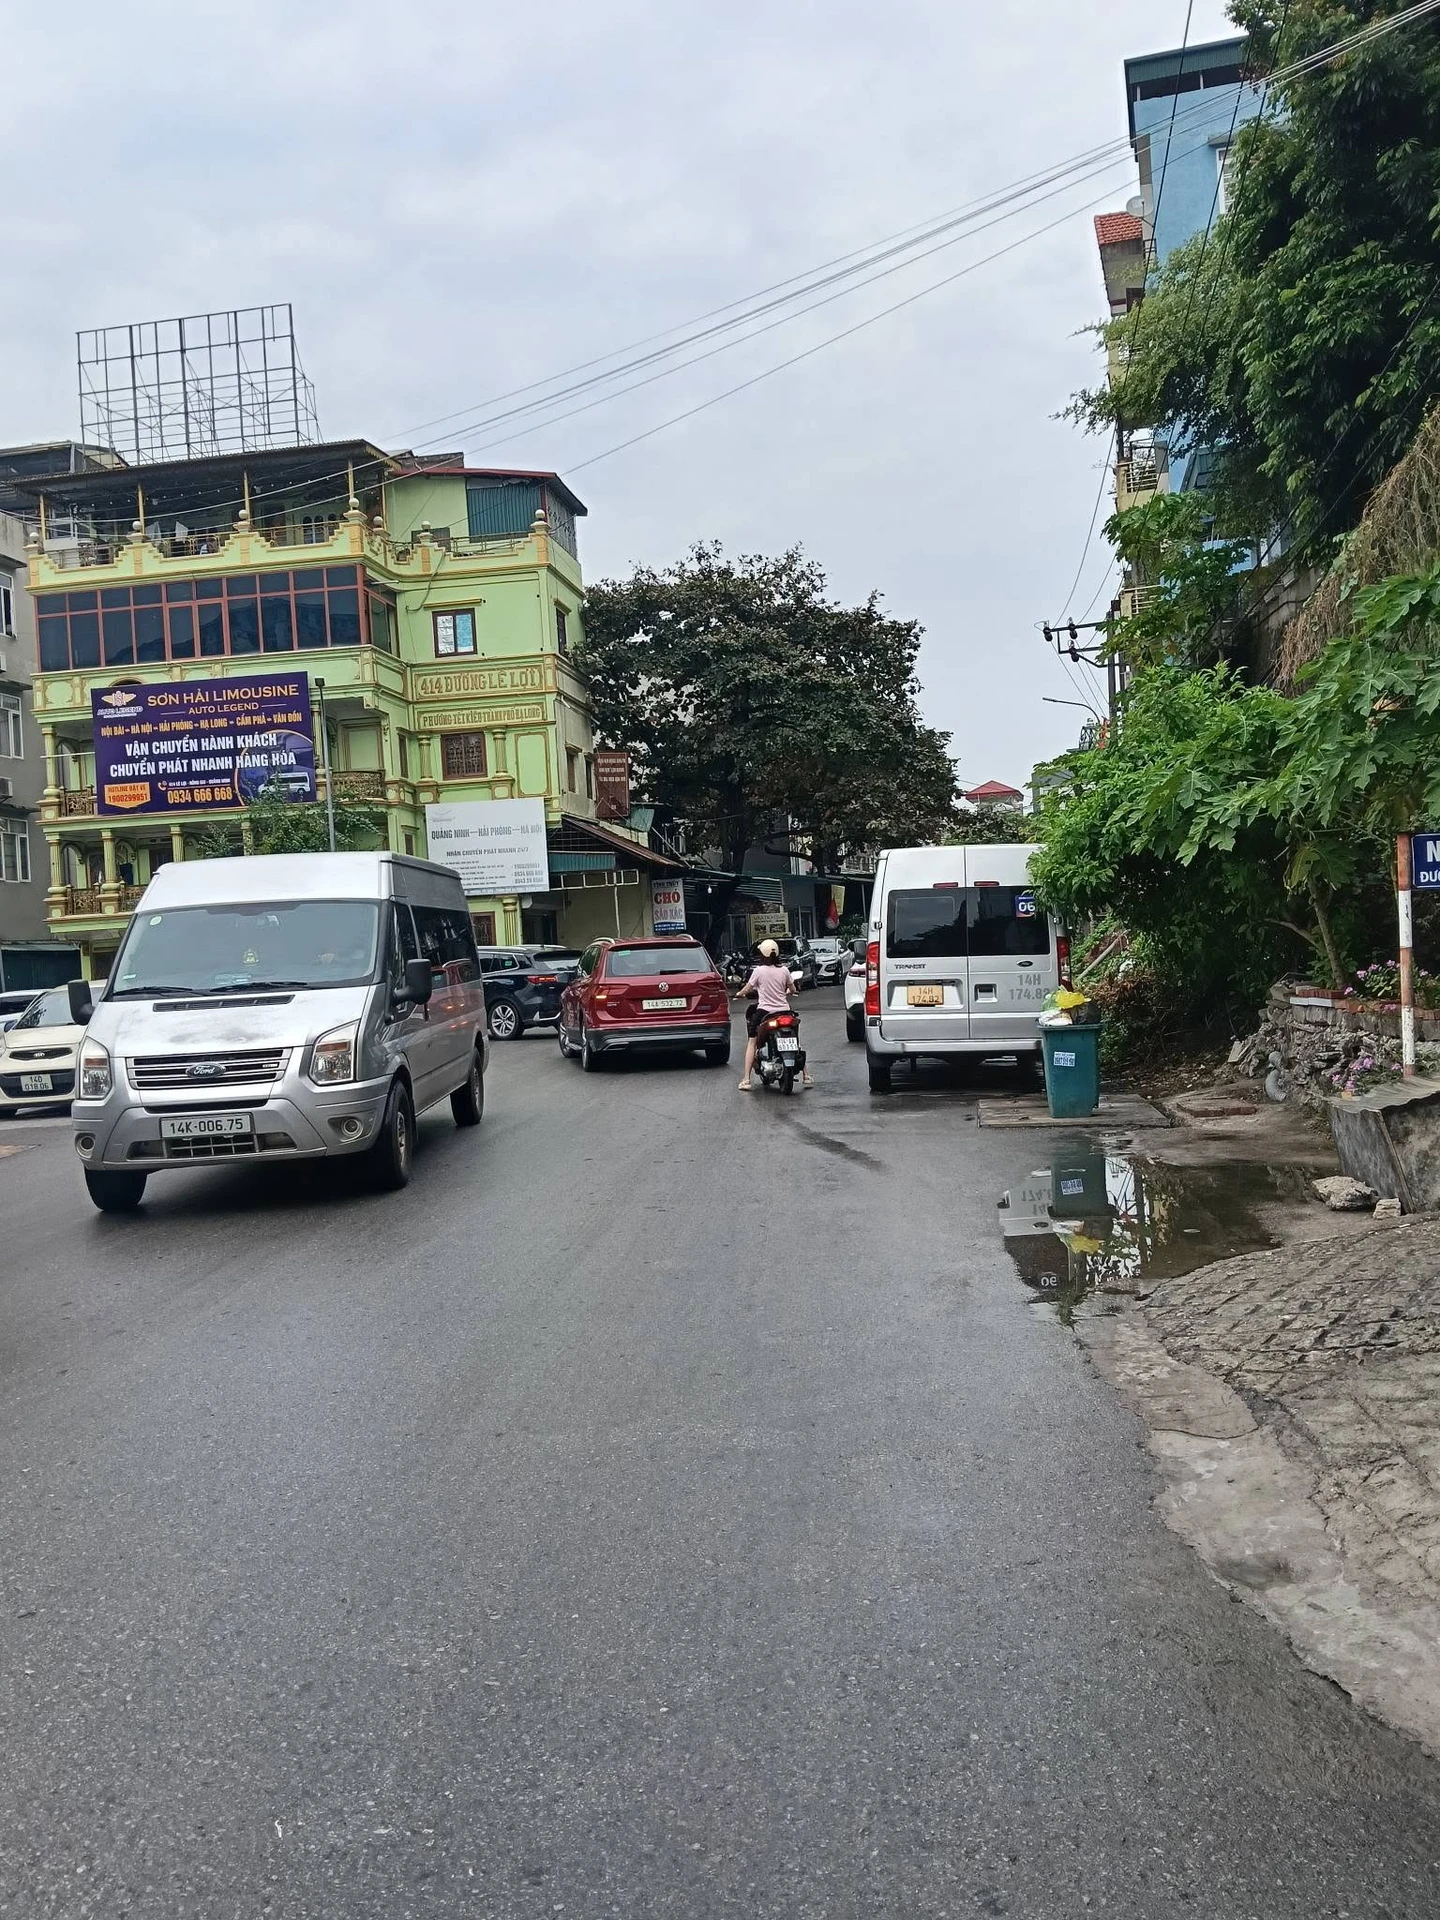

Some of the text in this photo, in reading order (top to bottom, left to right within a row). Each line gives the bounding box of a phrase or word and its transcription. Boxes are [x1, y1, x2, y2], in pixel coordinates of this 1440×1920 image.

[421, 677, 443, 695] 414
[488, 668, 507, 689] LÊ
[148, 684, 300, 707] SƠN HẢI LIMOUSINE
[188, 702, 259, 715] AUTO LEGEND
[125, 731, 278, 759] VẬN CHUYỂN HÀNH KHÁCH
[109, 750, 297, 778] CHUYỂN PHÁT NHANH HÀNG HÓA
[167, 786, 233, 804] 0934 666 668
[1420, 869, 1440, 883] ĐƯ
[1017, 973, 1041, 986] 14H
[918, 986, 934, 995] 14H
[193, 1065, 216, 1075] Ford
